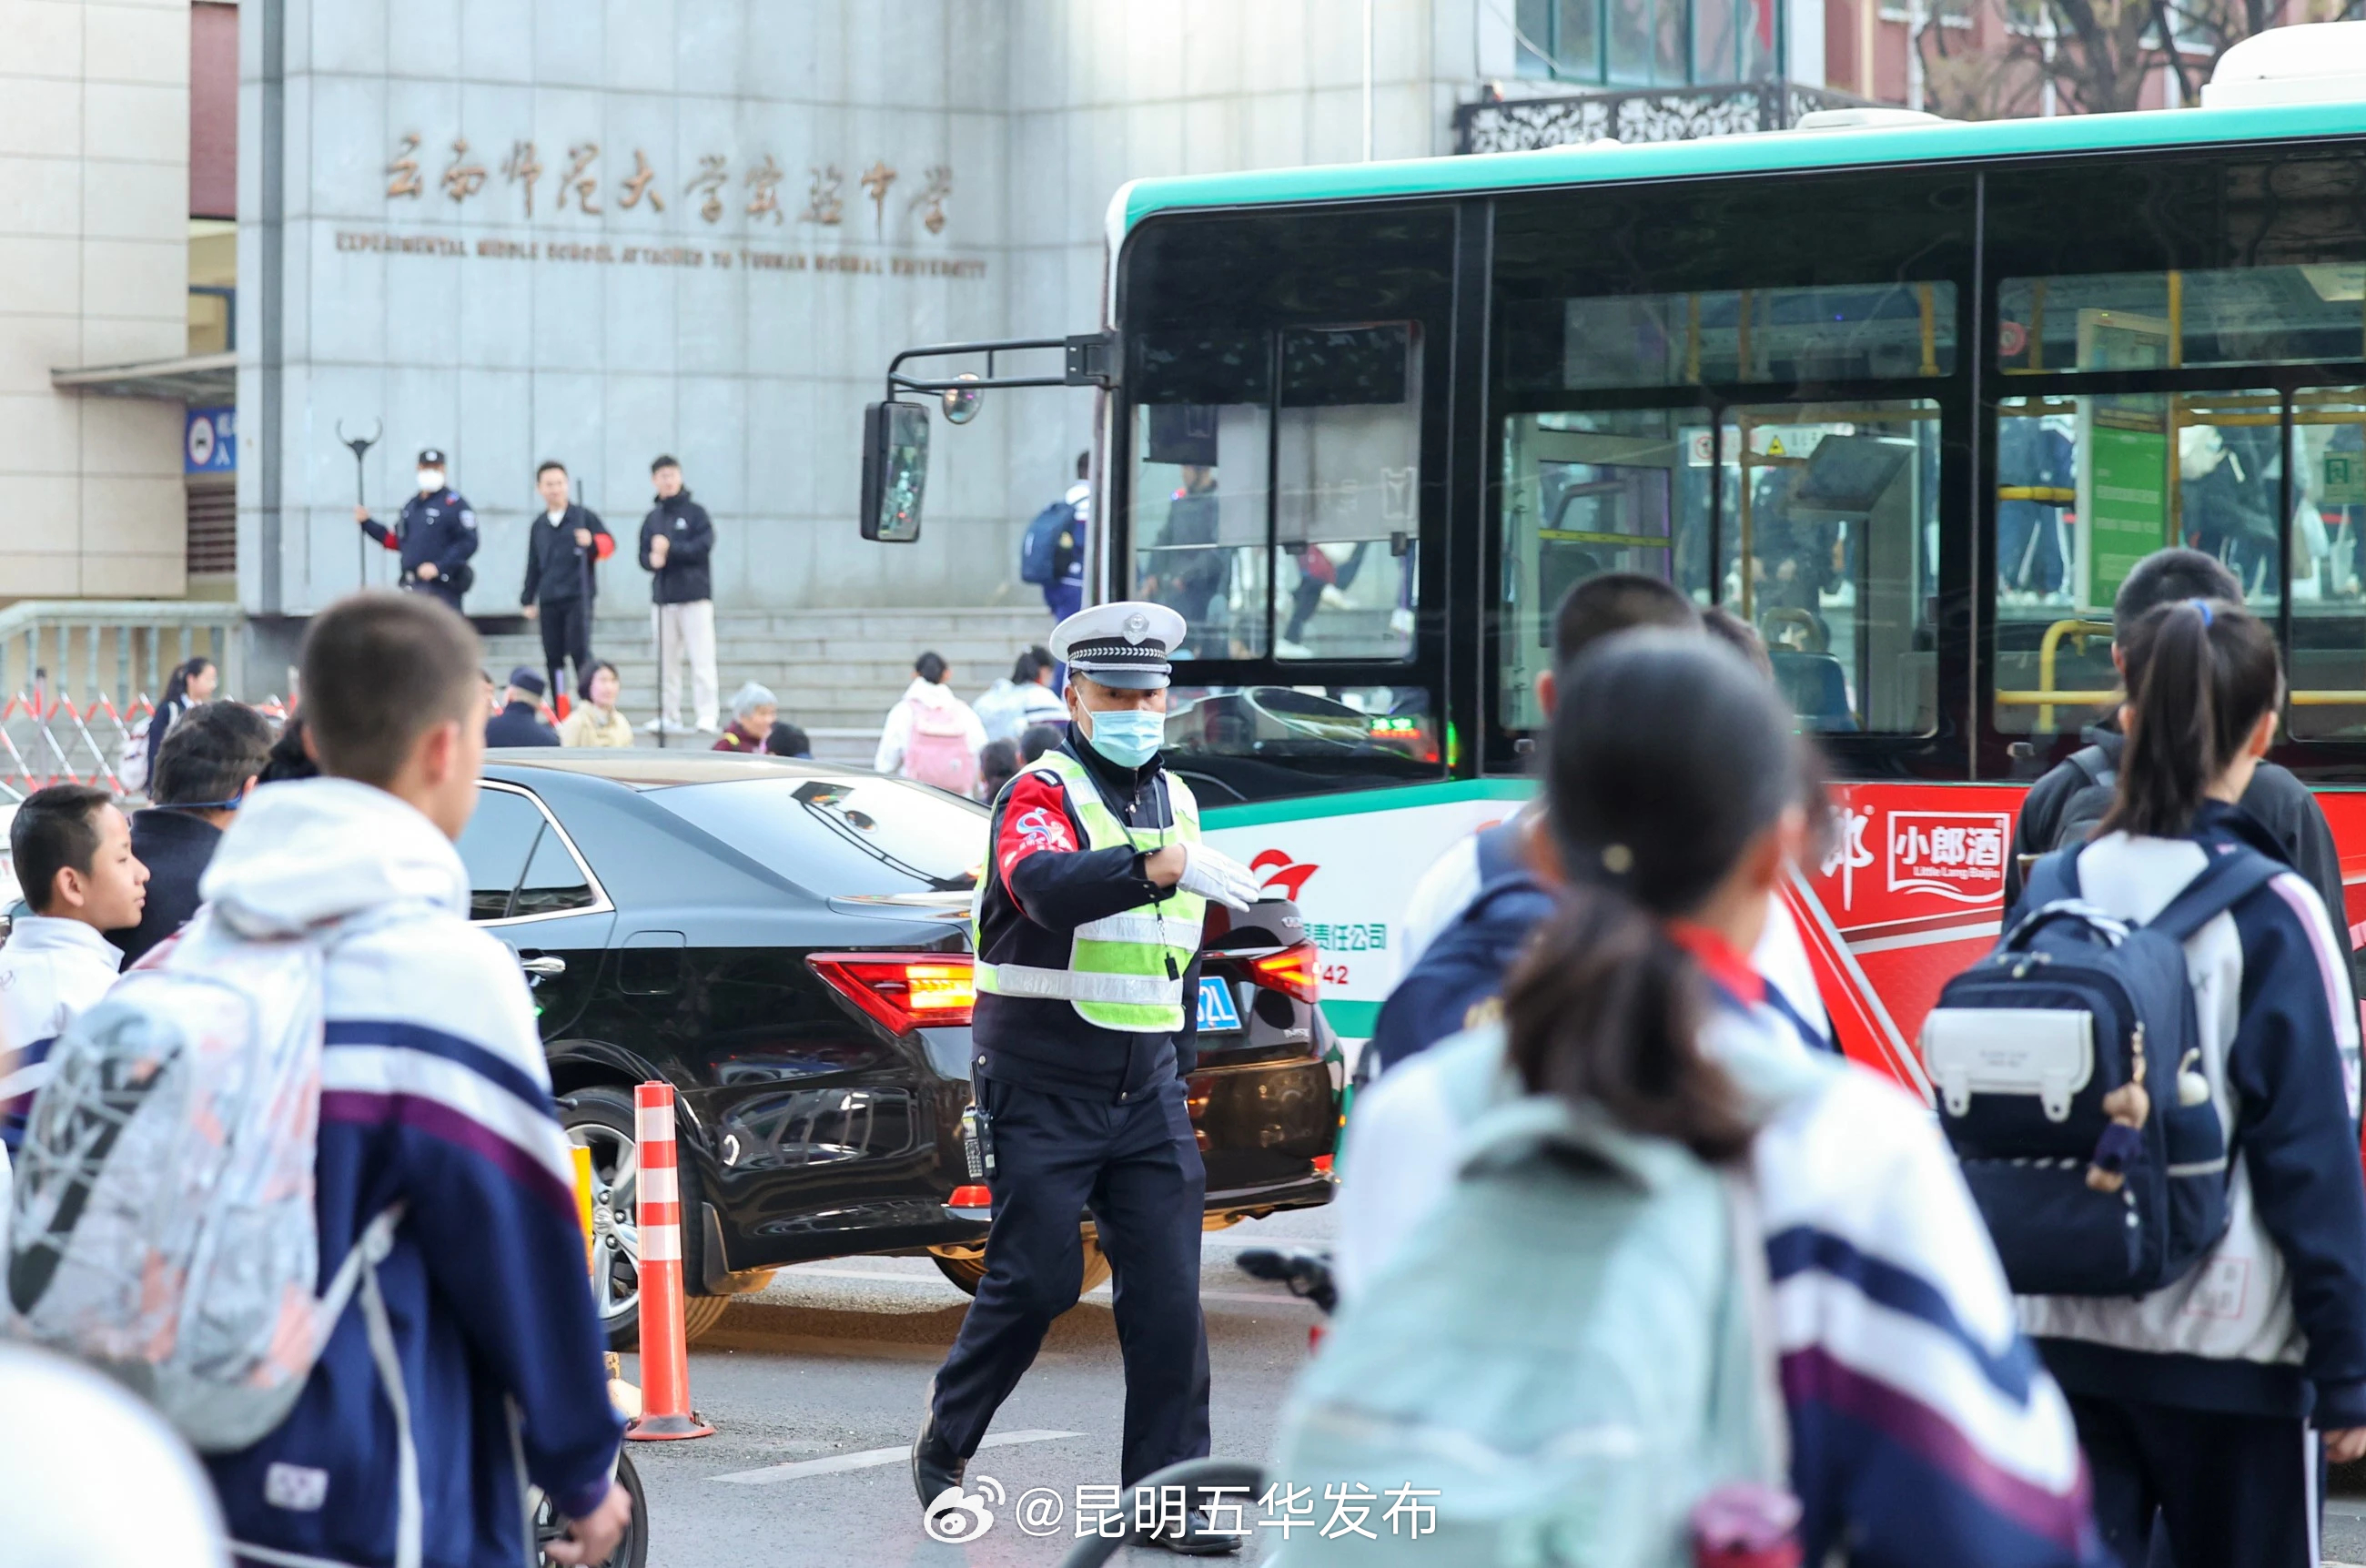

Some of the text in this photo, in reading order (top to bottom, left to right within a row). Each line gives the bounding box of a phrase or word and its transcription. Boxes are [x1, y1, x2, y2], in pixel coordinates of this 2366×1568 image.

[336, 231, 468, 258] EXPERIMENTAL
[478, 239, 539, 260] MIDDLE
[548, 242, 614, 264] SCHOOL
[622, 247, 703, 268] ATTACHED
[712, 249, 732, 270] TO
[1895, 825, 2002, 866] 小郎酒
[1913, 865, 2001, 881] Little Lang Baijiu
[1320, 965, 1349, 985] 42
